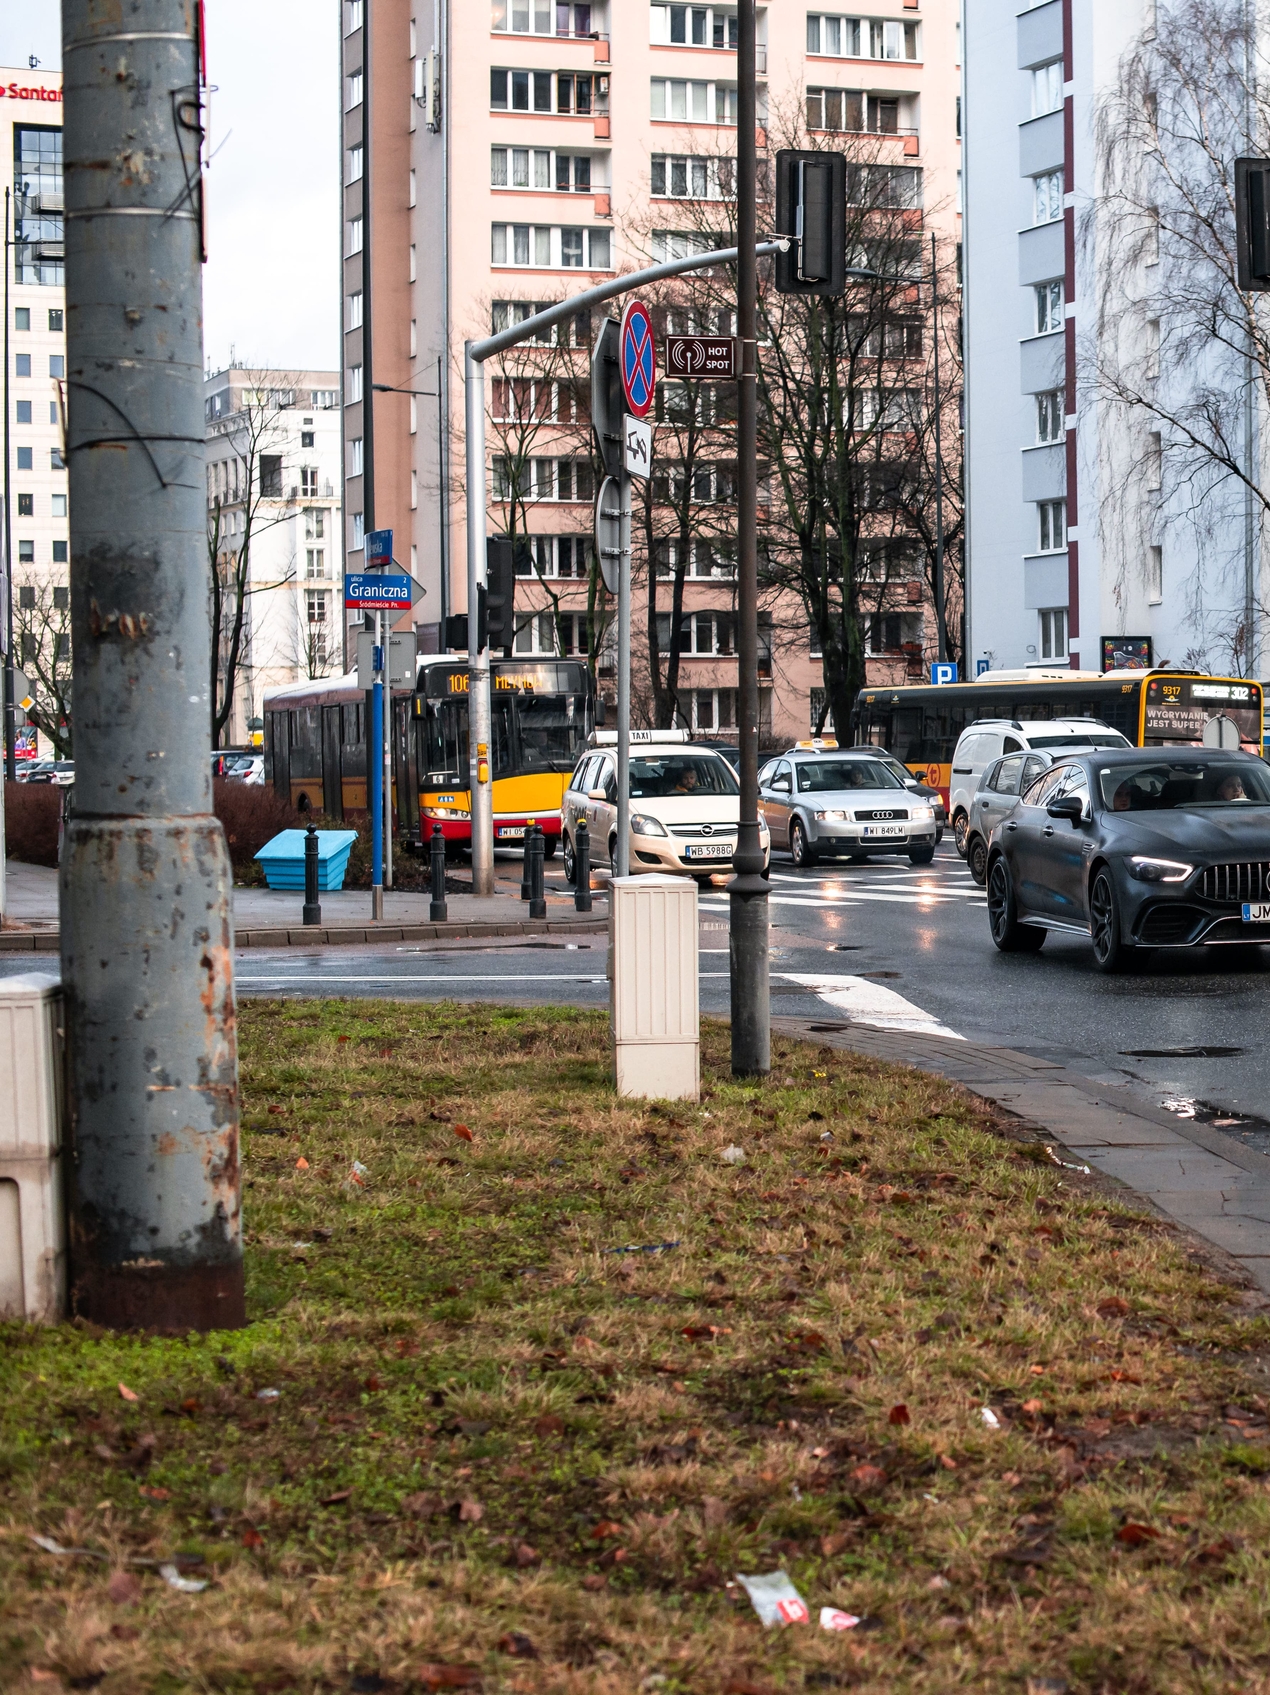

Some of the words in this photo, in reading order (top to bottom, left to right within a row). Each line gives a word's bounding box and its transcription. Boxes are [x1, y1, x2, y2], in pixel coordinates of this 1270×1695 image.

[708, 347, 727, 356] HOT
[706, 361, 730, 369] SPOT
[349, 584, 408, 598] Graniczna
[359, 600, 390, 608] Śródmieście
[937, 666, 952, 685] P
[449, 674, 470, 693] 106
[1162, 685, 1181, 695] 9317
[1231, 686, 1249, 700] 302
[1147, 710, 1209, 720] WYGRYWANIE
[1147, 719, 1170, 728] JEST
[1171, 720, 1200, 729] SUPER
[631, 732, 649, 740] TAXI
[503, 828, 511, 836] WI
[869, 827, 878, 835] WI
[881, 827, 903, 835] 849LM
[691, 847, 703, 856] WB
[706, 845, 732, 856] 5988G
